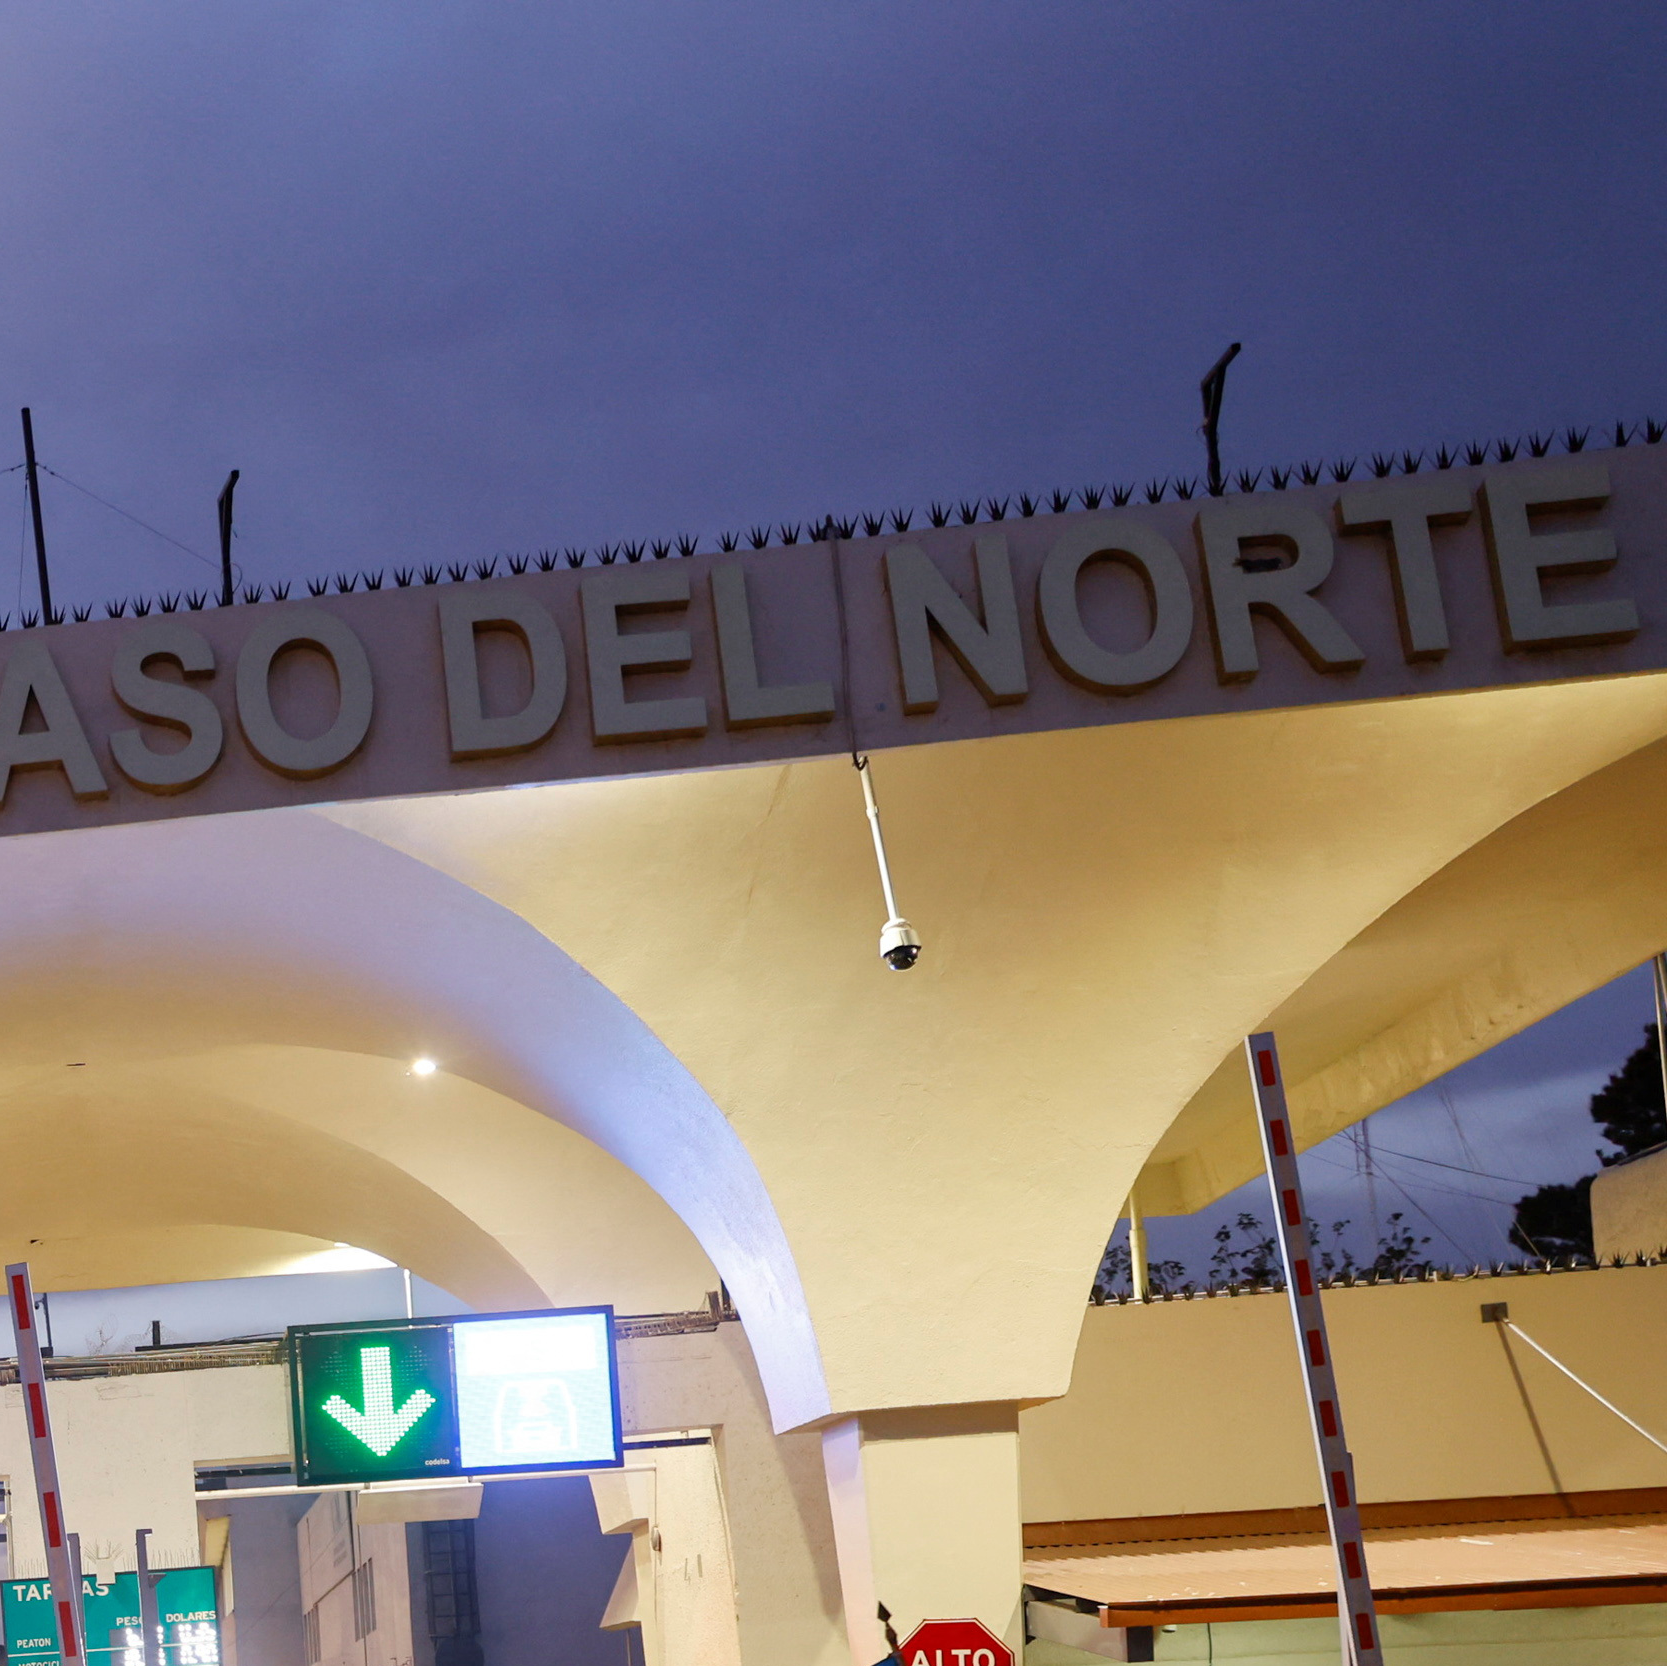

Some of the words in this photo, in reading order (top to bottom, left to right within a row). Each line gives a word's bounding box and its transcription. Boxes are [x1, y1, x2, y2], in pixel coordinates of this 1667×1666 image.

[439, 556, 836, 761] DEL
[883, 464, 1640, 715] NORTE
[166, 1610, 216, 1623] DOLARES
[17, 1638, 51, 1648] PEATON
